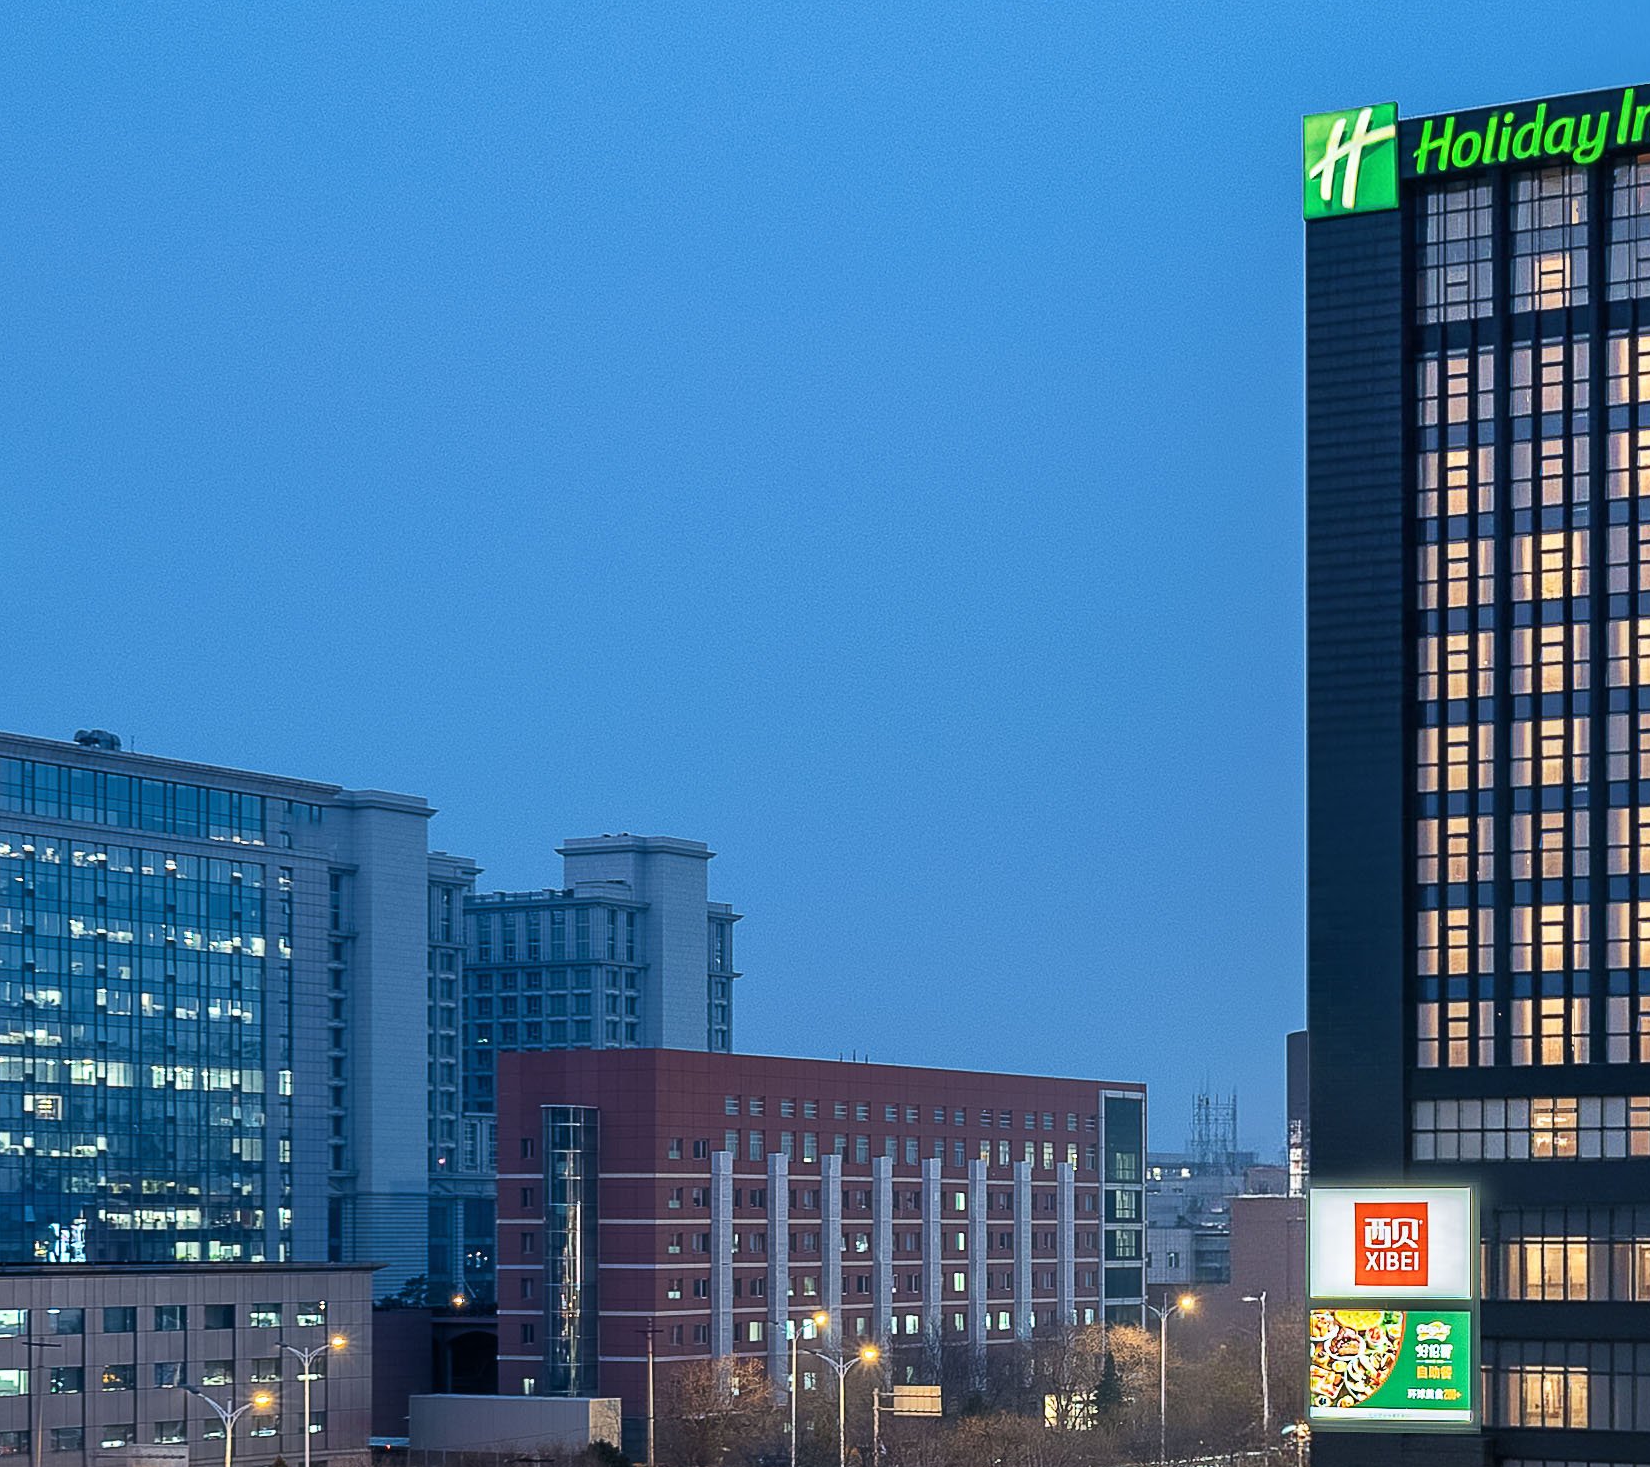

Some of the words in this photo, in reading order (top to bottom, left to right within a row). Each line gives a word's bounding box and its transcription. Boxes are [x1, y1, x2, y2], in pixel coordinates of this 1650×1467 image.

[1413, 104, 1612, 175] Holiday
[1364, 1217, 1419, 1249] 西贝
[1365, 1251, 1419, 1271] XIBEI
